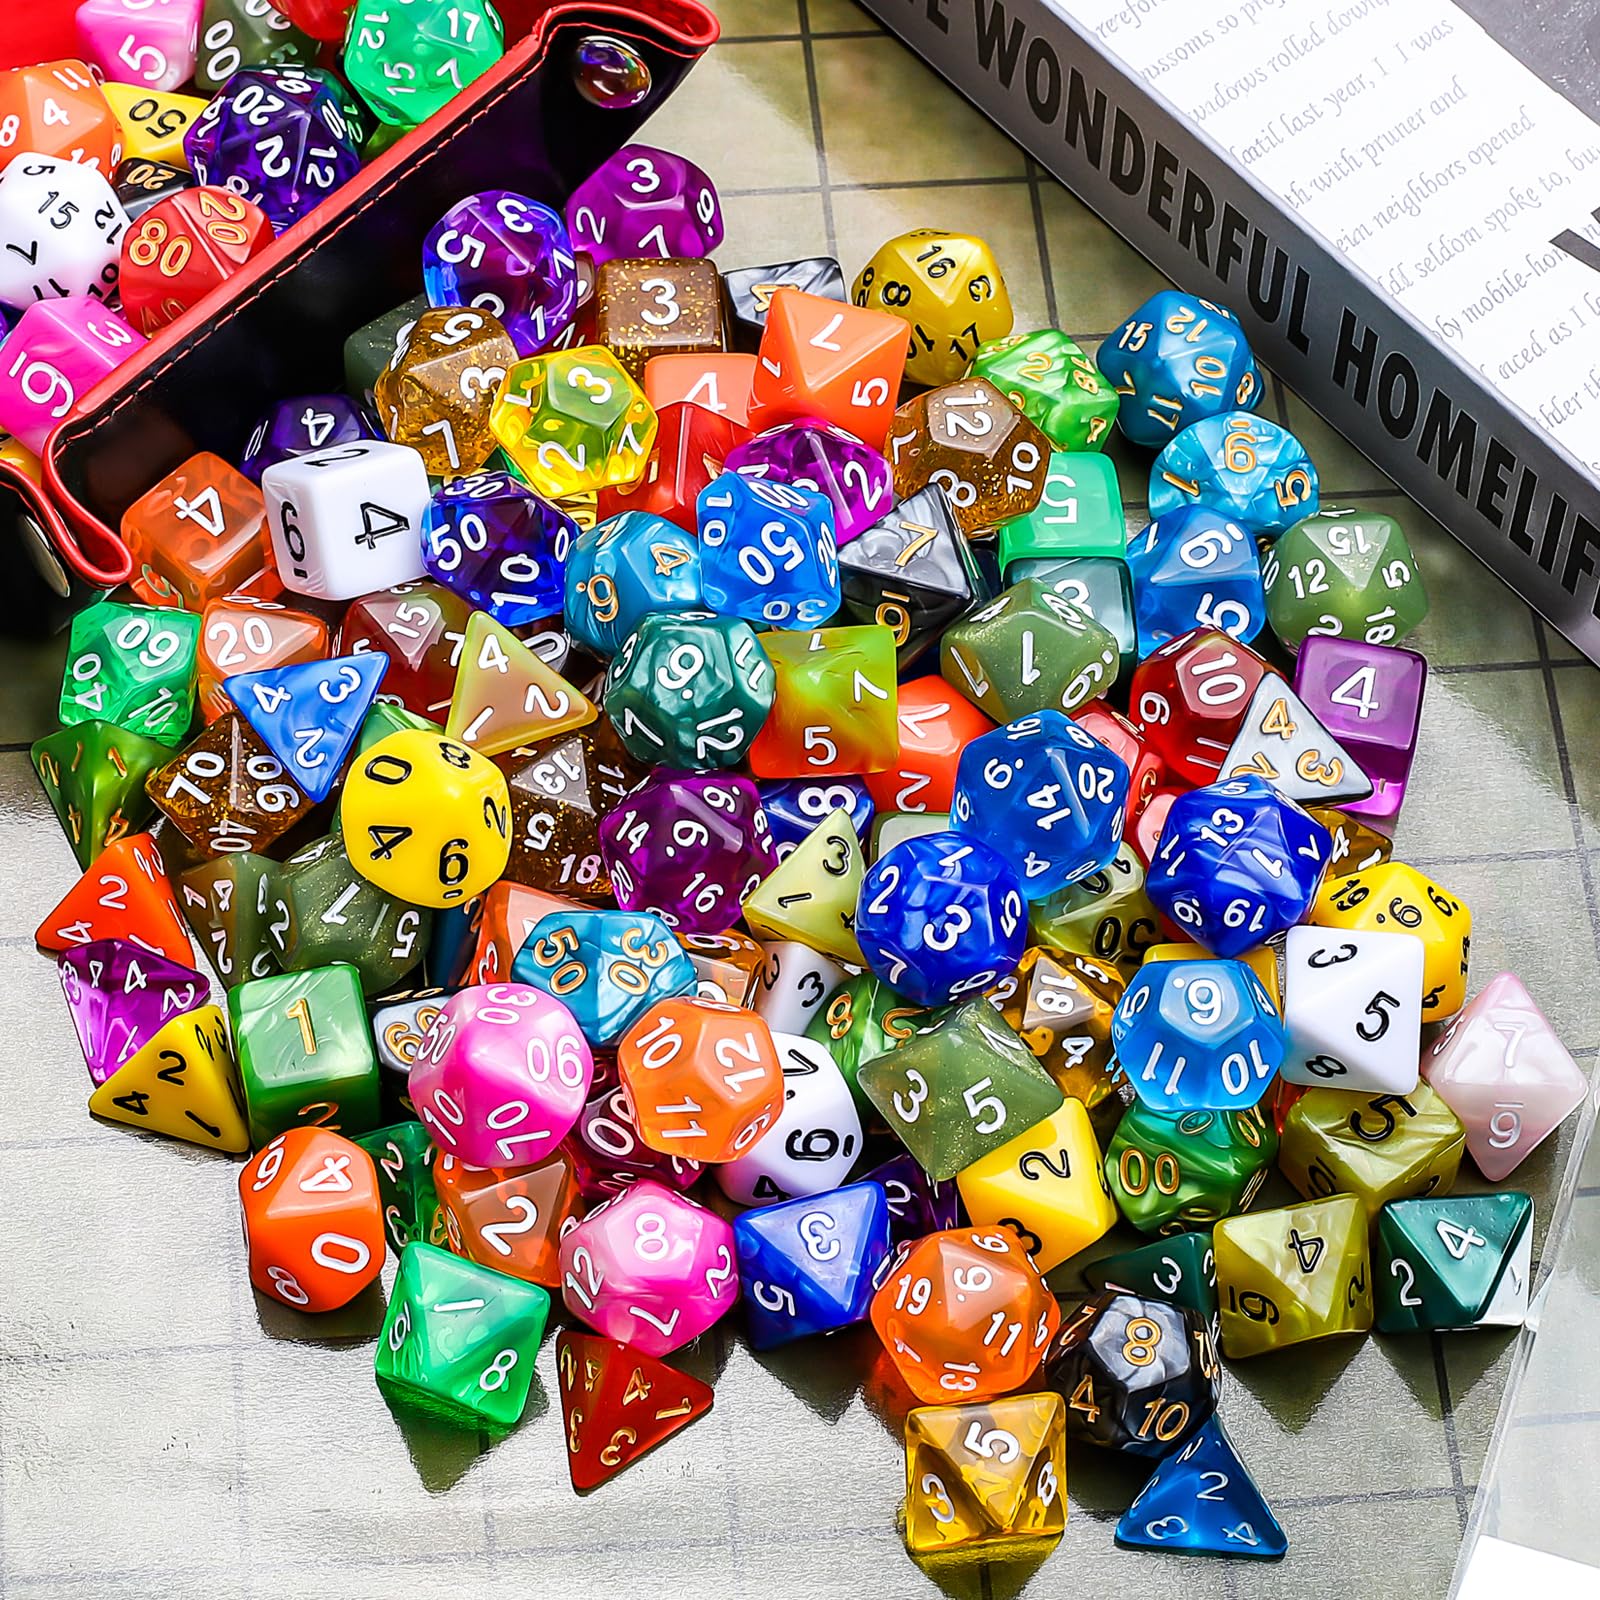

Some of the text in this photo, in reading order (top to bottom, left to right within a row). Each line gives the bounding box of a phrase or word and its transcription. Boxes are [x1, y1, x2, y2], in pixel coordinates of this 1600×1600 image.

[358, 10, 390, 49] 12
[447, 7, 480, 43] 17
[118, 35, 167, 81] 5
[204, 20, 241, 81] 00
[1267, 21, 1326, 73] rolled
[383, 61, 416, 96] 15
[1280, 103, 1324, 138] last
[1323, 73, 1377, 118] year,
[1410, 19, 1455, 53] was
[128, 99, 188, 139] 50
[231, 85, 286, 127] 20
[1310, 147, 1363, 192] with
[1361, 108, 1427, 168] pruner
[1430, 75, 1469, 116] and
[126, 164, 177, 190] 20
[255, 136, 291, 178] 2
[626, 158, 660, 193] 3
[1373, 159, 1467, 230] neighbors
[1468, 104, 1536, 165] opened
[38, 191, 80, 229] 15
[199, 190, 248, 246] 20
[496, 198, 534, 233] 3
[129, 218, 193, 277] 80
[436, 229, 487, 269] 5
[1414, 224, 1483, 279] seldom
[1484, 186, 1542, 234] spoke
[916, 244, 957, 279] 16
[639, 278, 681, 326] 3
[974, 0, 1600, 621] WONDERFUL HOMELIF
[87, 321, 132, 347] 3
[430, 313, 483, 345] 5
[809, 314, 844, 351] 7
[1166, 306, 1208, 342] 12
[567, 366, 612, 404] 3
[1016, 352, 1052, 382] 2
[1190, 356, 1227, 398] 10
[943, 390, 993, 437] 12
[422, 419, 460, 469] 7
[538, 440, 586, 472] 2
[843, 461, 882, 512] 2
[928, 469, 977, 507] 8
[1006, 441, 1041, 495] 10
[1044, 473, 1078, 525] 5
[1274, 470, 1311, 510] 5
[173, 487, 225, 536] 4
[354, 502, 410, 550] 4
[703, 491, 732, 546] 10
[430, 513, 487, 571] 50
[650, 542, 691, 576] 4
[738, 521, 805, 586] 50
[896, 521, 938, 566] 7
[1327, 524, 1371, 556] 15
[491, 553, 540, 605] 10
[1287, 558, 1329, 599] 12
[387, 601, 432, 639] 15
[1195, 592, 1251, 639] 5
[1365, 606, 1397, 645] 18
[208, 617, 274, 667] 20
[72, 653, 108, 712] 40
[252, 683, 292, 714] 4
[319, 666, 360, 703] 3
[1190, 653, 1246, 705] 10
[1331, 666, 1379, 718] 4
[129, 688, 178, 728] 10
[524, 684, 569, 719] 2
[1260, 698, 1297, 740] 4
[696, 708, 744, 760] 12
[804, 726, 837, 765] 5
[364, 755, 412, 785] 0
[439, 743, 470, 769] 8
[533, 751, 580, 795] 13
[1296, 750, 1343, 786] 3
[165, 751, 224, 805] 70
[896, 771, 931, 813] 2
[1078, 762, 1115, 803] 20
[798, 785, 857, 817] 8
[1026, 784, 1071, 831] 14
[368, 826, 412, 860] 4
[615, 810, 649, 853] 14
[1200, 808, 1244, 847] 13
[1332, 827, 1350, 864] 4
[560, 854, 602, 884] 18
[1024, 852, 1050, 878] 4
[100, 875, 128, 909] 2
[683, 872, 724, 913] 16
[868, 866, 900, 915] 2
[1330, 879, 1370, 911] 19
[391, 910, 419, 958] 5
[923, 905, 971, 952] 3
[1000, 890, 1021, 938] 5
[1223, 899, 1266, 932] 19
[534, 929, 587, 995] 50
[609, 927, 668, 997] 30
[1309, 944, 1357, 969] 3
[477, 987, 537, 1024] 30
[1036, 974, 1078, 1014] 18
[286, 998, 317, 1055] 1
[825, 992, 853, 1040] 8
[1356, 990, 1400, 1042] 5
[418, 1014, 457, 1064] 50
[635, 1016, 683, 1070] 10
[1494, 1022, 1528, 1067] 7
[157, 1050, 187, 1085] 2
[714, 1032, 766, 1093] 12
[1141, 1042, 1186, 1096] 11
[1221, 1040, 1270, 1096] 10
[1305, 1054, 1347, 1079] 8
[112, 1091, 149, 1115] 4
[423, 1089, 464, 1145] 10
[656, 1096, 707, 1138] 11
[894, 1069, 929, 1123] 3
[963, 1077, 1007, 1135] 5
[185, 1110, 221, 1137] 1
[487, 1101, 552, 1160] 70
[299, 1156, 352, 1193] 4
[1020, 1149, 1070, 1181] 2
[480, 1195, 538, 1255] 2
[800, 1212, 840, 1261] 3
[1437, 1219, 1485, 1260] 4
[311, 1232, 370, 1274] 0
[1289, 1228, 1326, 1274] 4
[565, 1246, 605, 1309] 12
[896, 1273, 932, 1315] 19
[1153, 1257, 1182, 1294] 3
[754, 1281, 795, 1316] 5
[983, 1311, 1022, 1356] 11
[1123, 1316, 1162, 1366] 8
[479, 1348, 519, 1392] 8
[623, 1367, 651, 1405] 4
[655, 1398, 692, 1419] 1
[1137, 1397, 1190, 1441] 10
[600, 1426, 637, 1466] 3
[963, 1420, 1020, 1463] 5
[922, 1473, 955, 1523] 3
[1196, 1471, 1229, 1501] 2
[1146, 1516, 1190, 1540] 3
